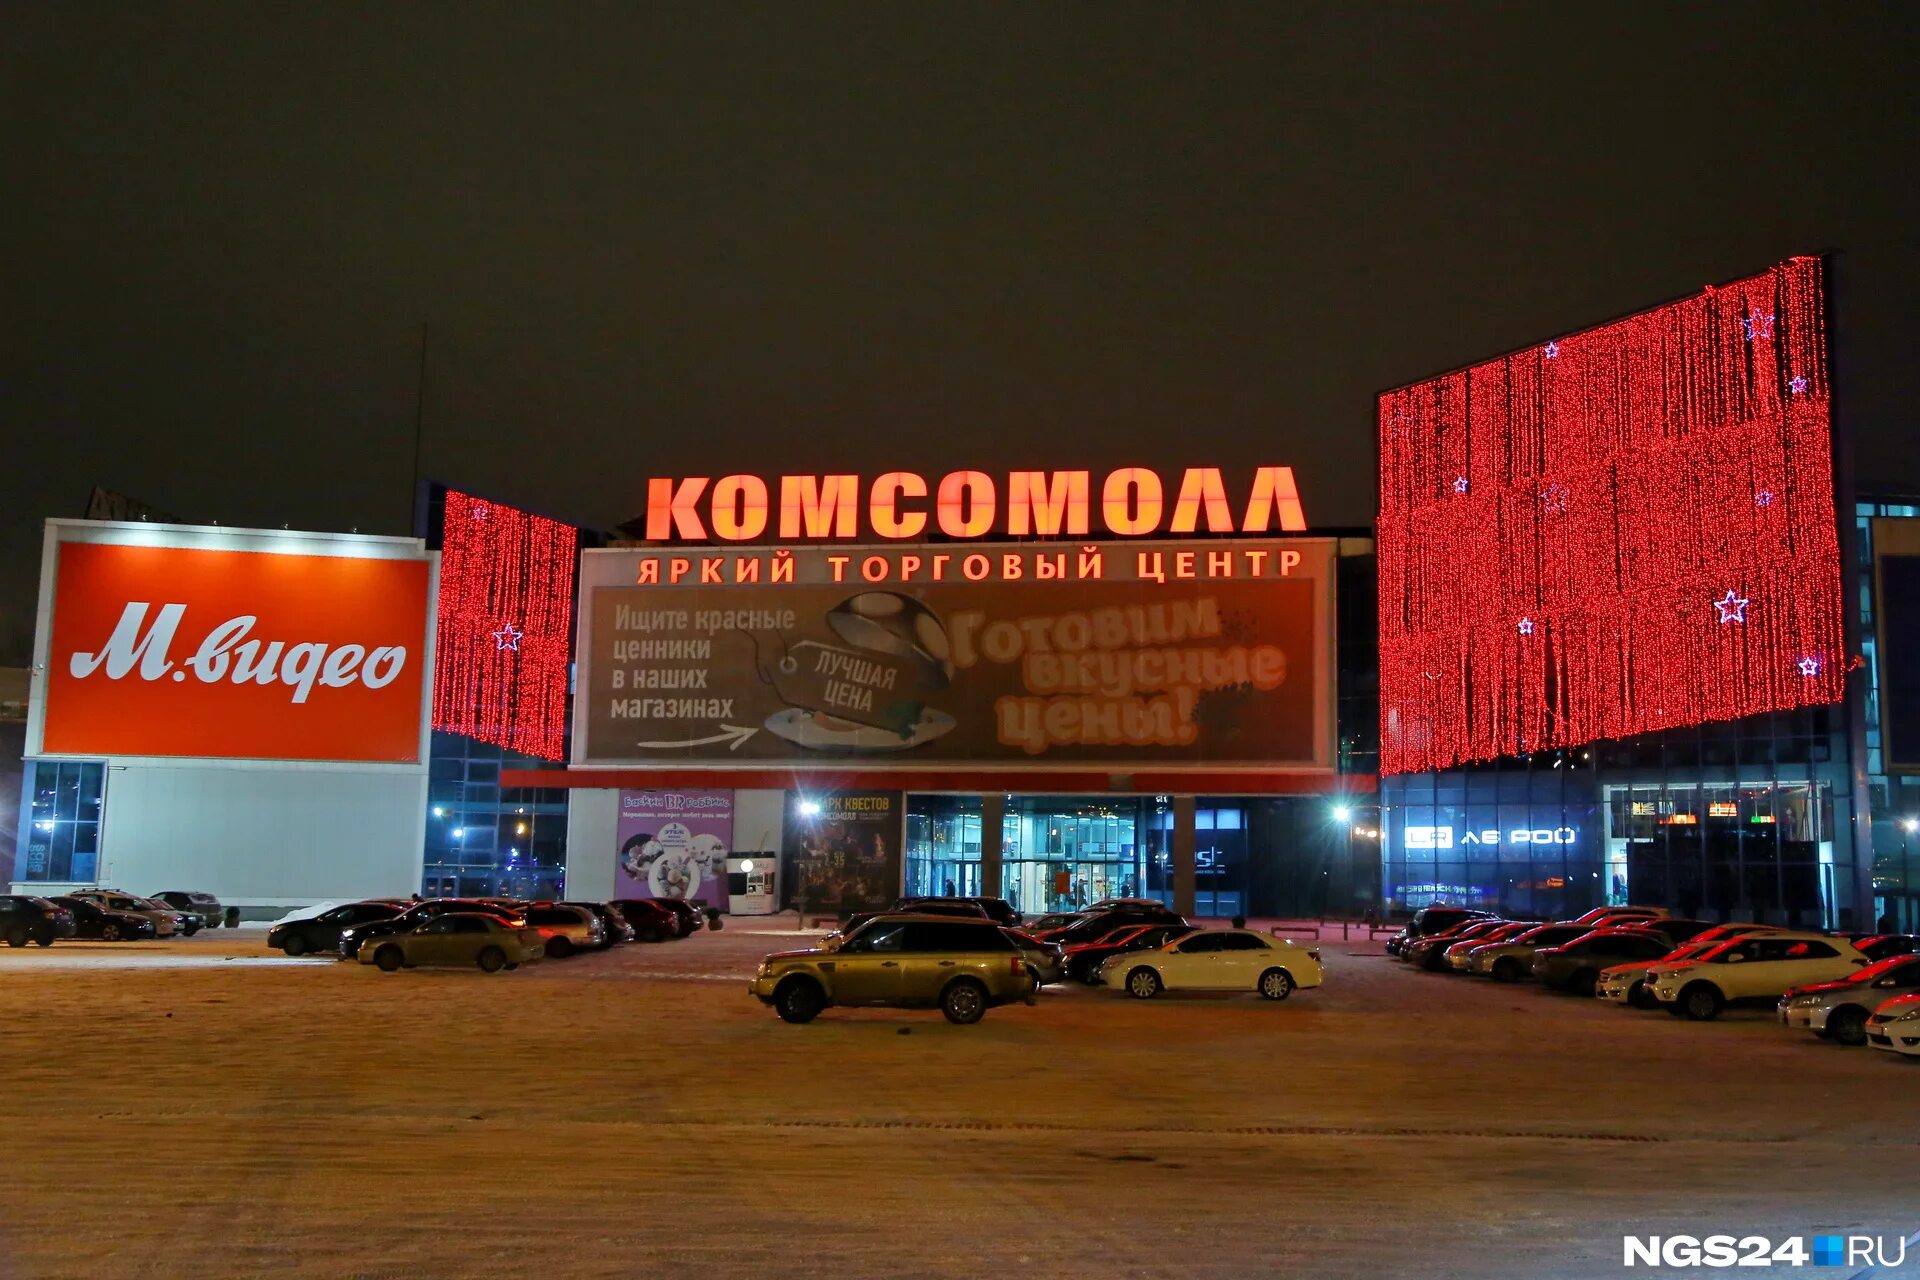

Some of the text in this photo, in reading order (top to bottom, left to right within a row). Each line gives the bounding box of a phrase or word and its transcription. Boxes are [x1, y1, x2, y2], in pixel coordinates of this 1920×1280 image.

[645, 467, 1307, 540] КОМСОМОЛЛ
[637, 547, 1303, 584] ЯРКИЙ ТОРГОВЫЙ ЦЕНТР
[615, 604, 795, 634] Ищите красные
[951, 598, 1220, 665] Готовим
[70, 602, 406, 703] М.видео
[613, 640, 711, 661] ценники
[612, 670, 707, 689] в наших
[815, 650, 897, 691] ЛУЧШАЯ
[1027, 648, 1286, 694] вкусные
[610, 698, 733, 719] магазинах
[822, 681, 874, 712] ЦЕНА
[997, 688, 1196, 753] цены!
[624, 796, 663, 808] Баскин
[845, 797, 889, 810] КВЕСТОВ
